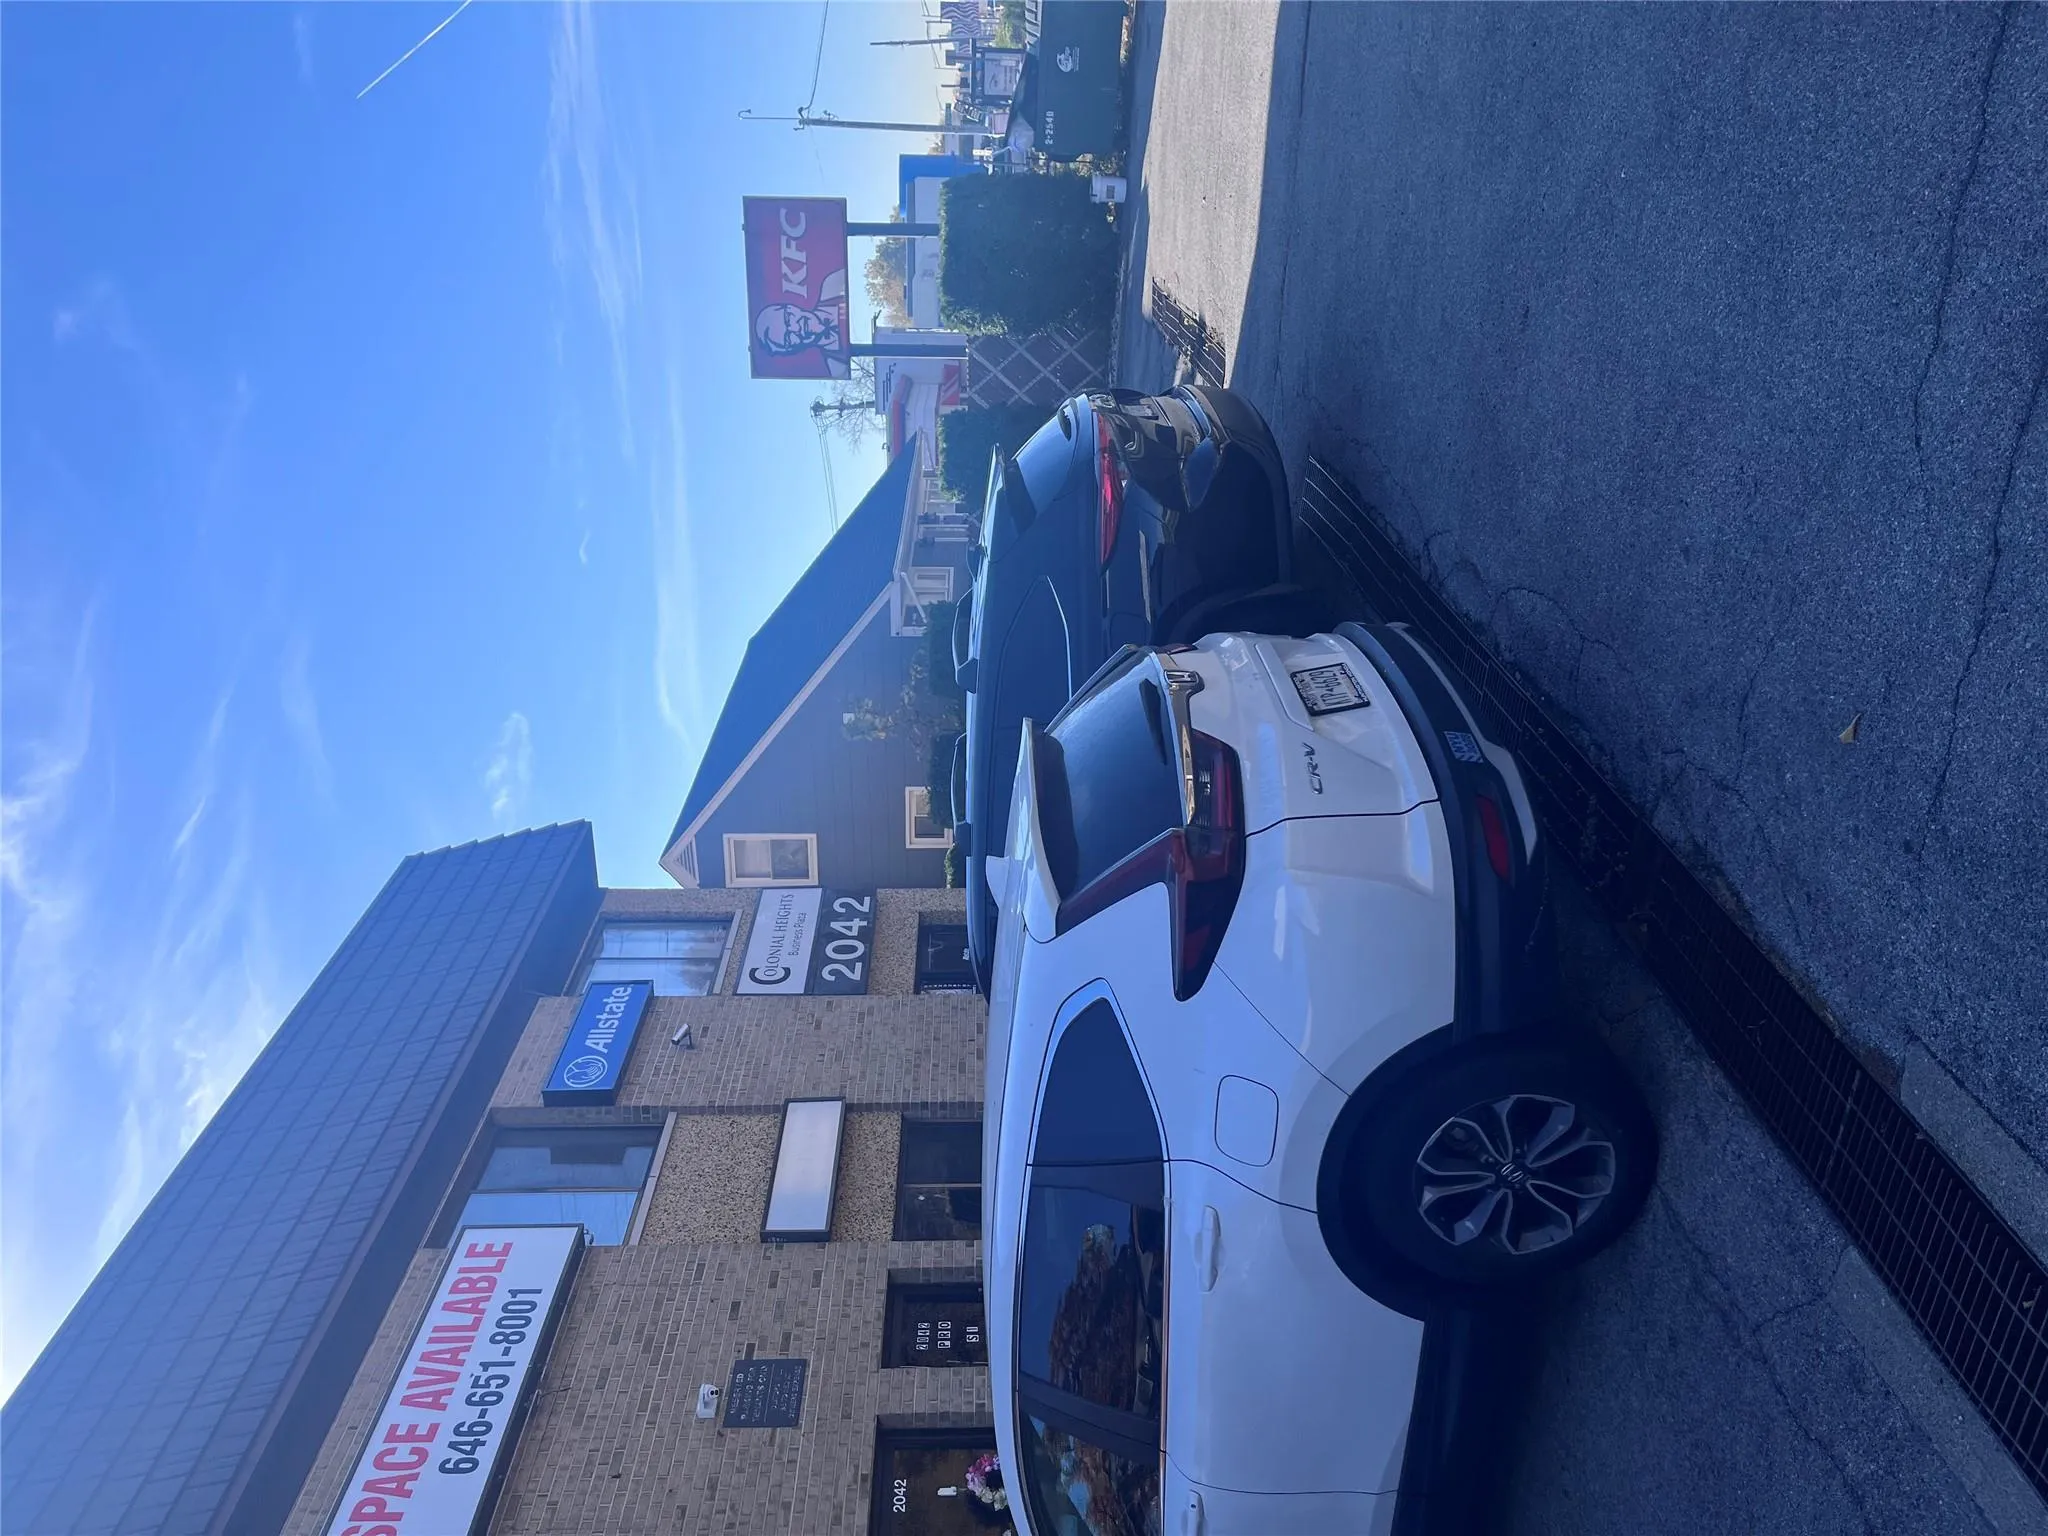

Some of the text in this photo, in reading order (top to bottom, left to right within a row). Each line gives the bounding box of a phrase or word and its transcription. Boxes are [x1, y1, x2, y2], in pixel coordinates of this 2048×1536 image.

[779, 208, 807, 299] KFC
[1302, 742, 1323, 795] CR-V
[775, 894, 795, 932] HEIGHTS
[788, 912, 807, 956] Business Plaza
[821, 896, 871, 981] 2042
[585, 986, 632, 1054] Allstate
[400, 1242, 513, 1411] AVAILABLE
[916, 1322, 930, 1350] 2042
[938, 1321, 951, 1348] PRO
[438, 1288, 542, 1475] 646-651-8001
[893, 1479, 907, 1512] 2042
